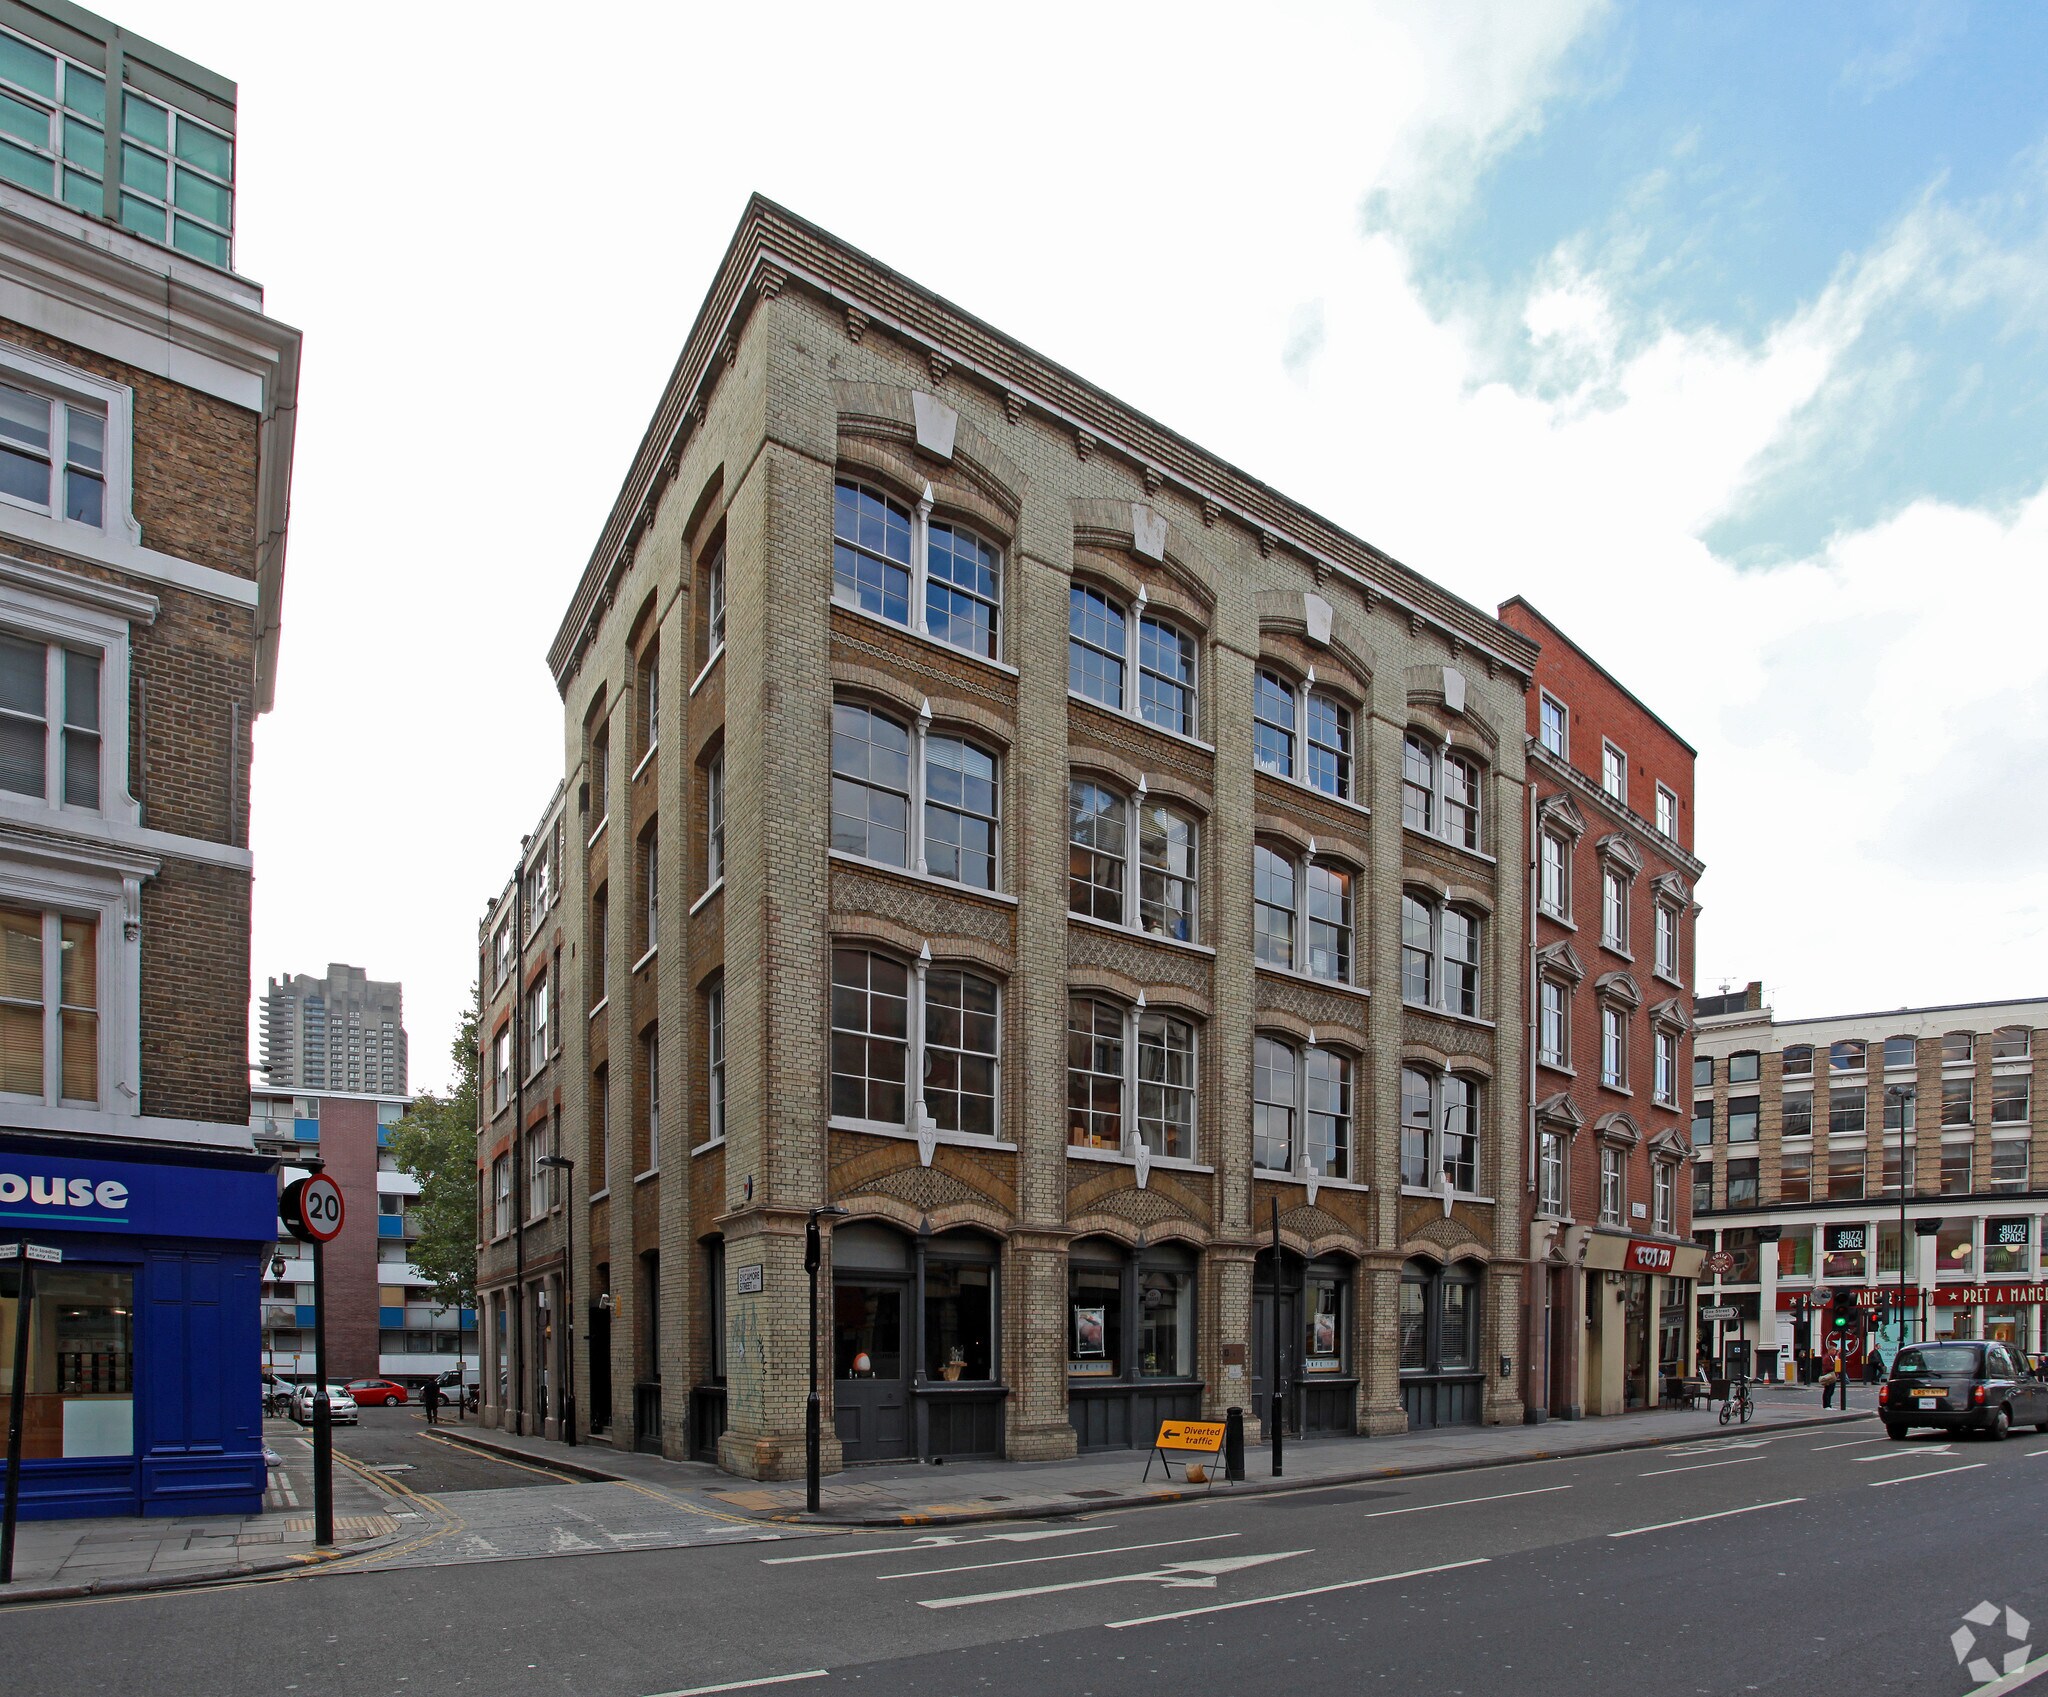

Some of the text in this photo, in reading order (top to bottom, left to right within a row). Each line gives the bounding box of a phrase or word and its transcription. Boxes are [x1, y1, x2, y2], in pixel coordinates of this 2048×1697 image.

[0, 1173, 129, 1210] ouse
[309, 1192, 339, 1222] 20
[1999, 1233, 2026, 1243] SPACE
[1838, 1239, 1863, 1249] SPACE
[40, 1248, 60, 1256] loading
[1636, 1246, 1671, 1268] COSTA
[1712, 1253, 1728, 1261] COSTA
[740, 1271, 760, 1282] SYCAMORE
[740, 1281, 752, 1292] STREET
[1963, 1288, 1990, 1303] PRET
[1996, 1288, 2004, 1302] A
[1184, 1426, 1221, 1436] Diverted
[1185, 1436, 1213, 1446] traffic
